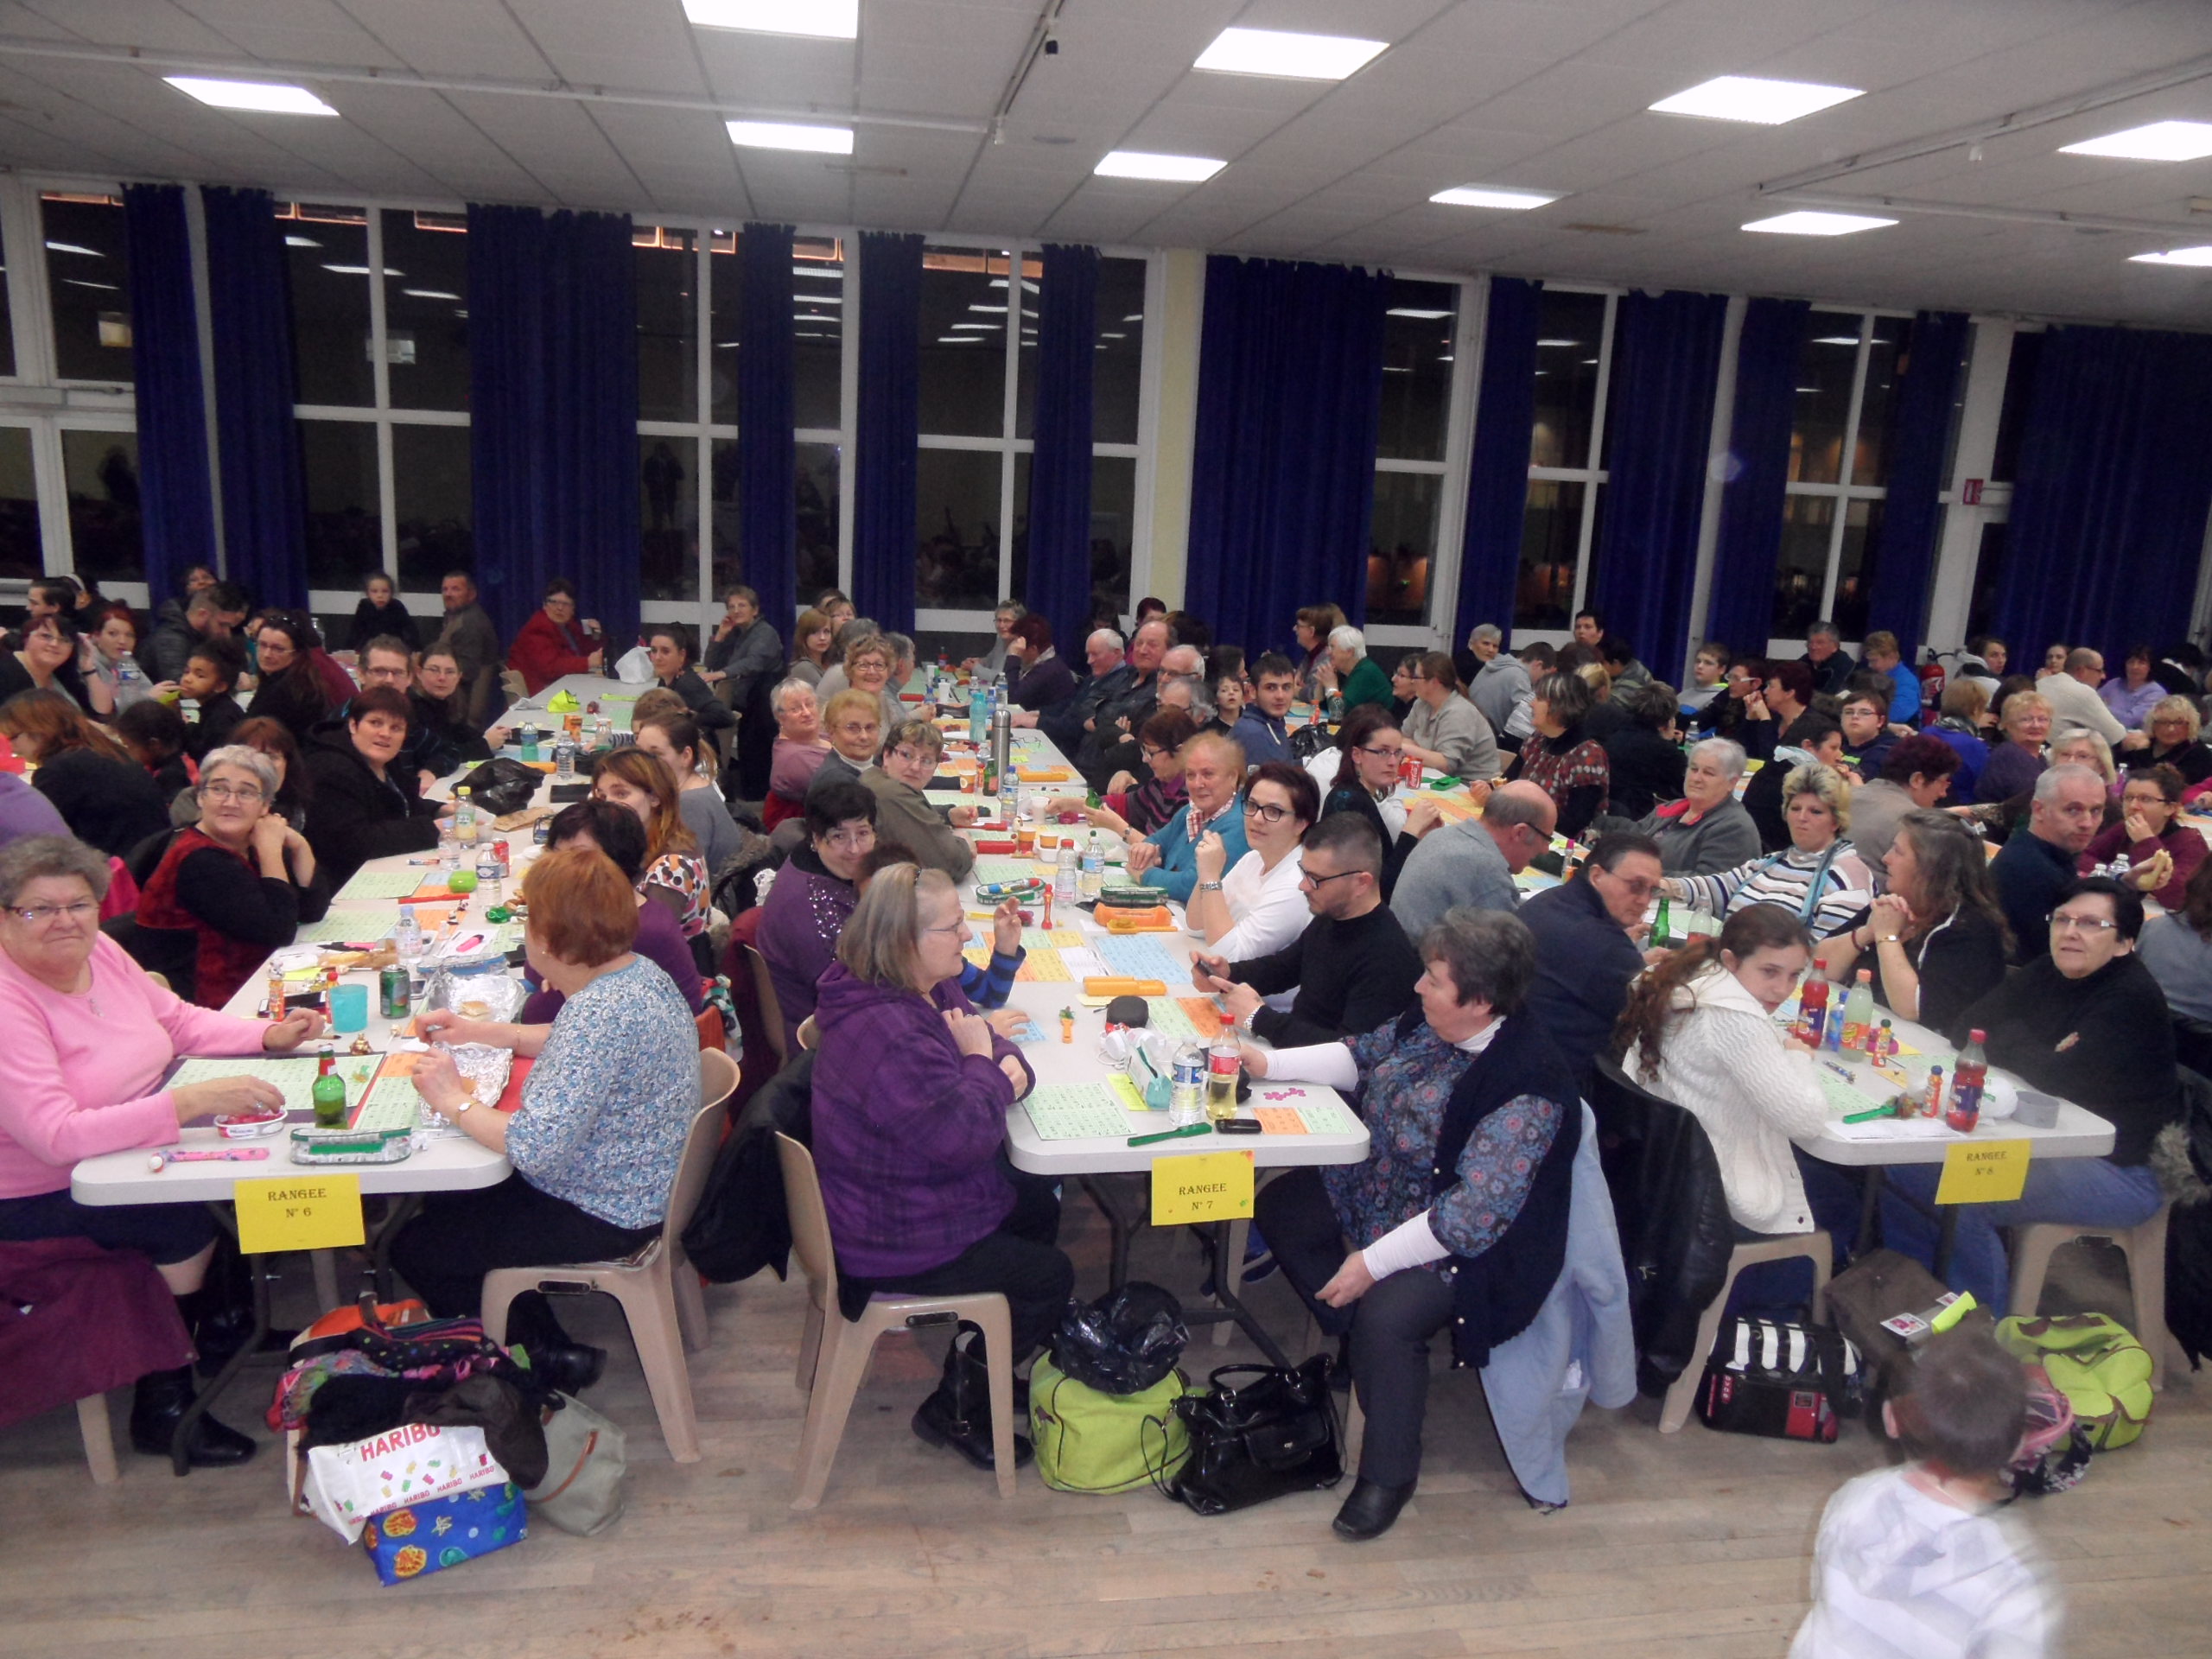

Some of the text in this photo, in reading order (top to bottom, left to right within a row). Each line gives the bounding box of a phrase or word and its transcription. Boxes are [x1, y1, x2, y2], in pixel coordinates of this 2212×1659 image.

[1966, 1150, 2008, 1162] RANGEE
[267, 1187, 327, 1202] RANGEE
[1178, 1182, 1228, 1196] RANGEE
[302, 1206, 312, 1217] 6
[1206, 1200, 1214, 1210] 7
[359, 1423, 442, 1462] HARIBO
[404, 1489, 430, 1504] HARIBO
[436, 1478, 463, 1493] HARIBO
[469, 1465, 495, 1480] HARIBO
